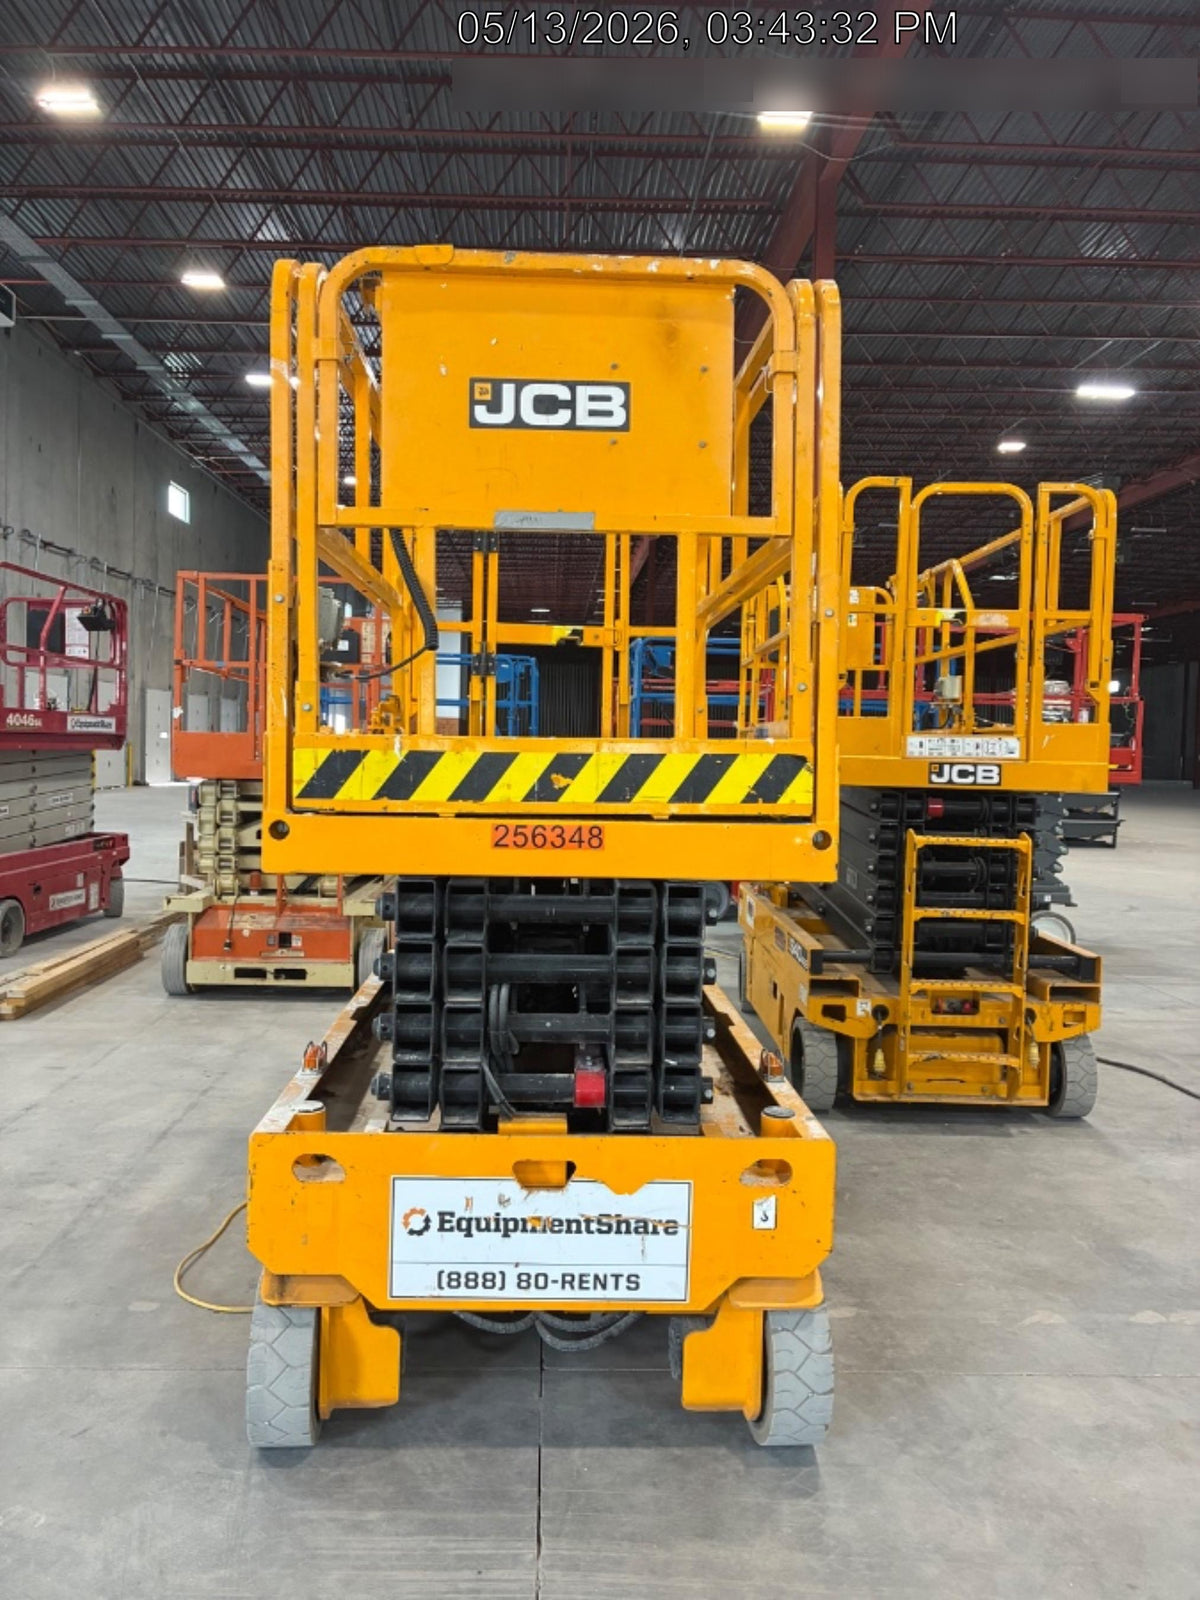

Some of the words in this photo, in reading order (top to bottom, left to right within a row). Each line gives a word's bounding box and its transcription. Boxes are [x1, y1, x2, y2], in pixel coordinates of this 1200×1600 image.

[474, 383, 627, 427] JCB
[930, 764, 1000, 784] JCB
[493, 824, 604, 849] 256348
[437, 1270, 506, 1291] (888)
[516, 1272, 641, 1291] 80-RENTS
